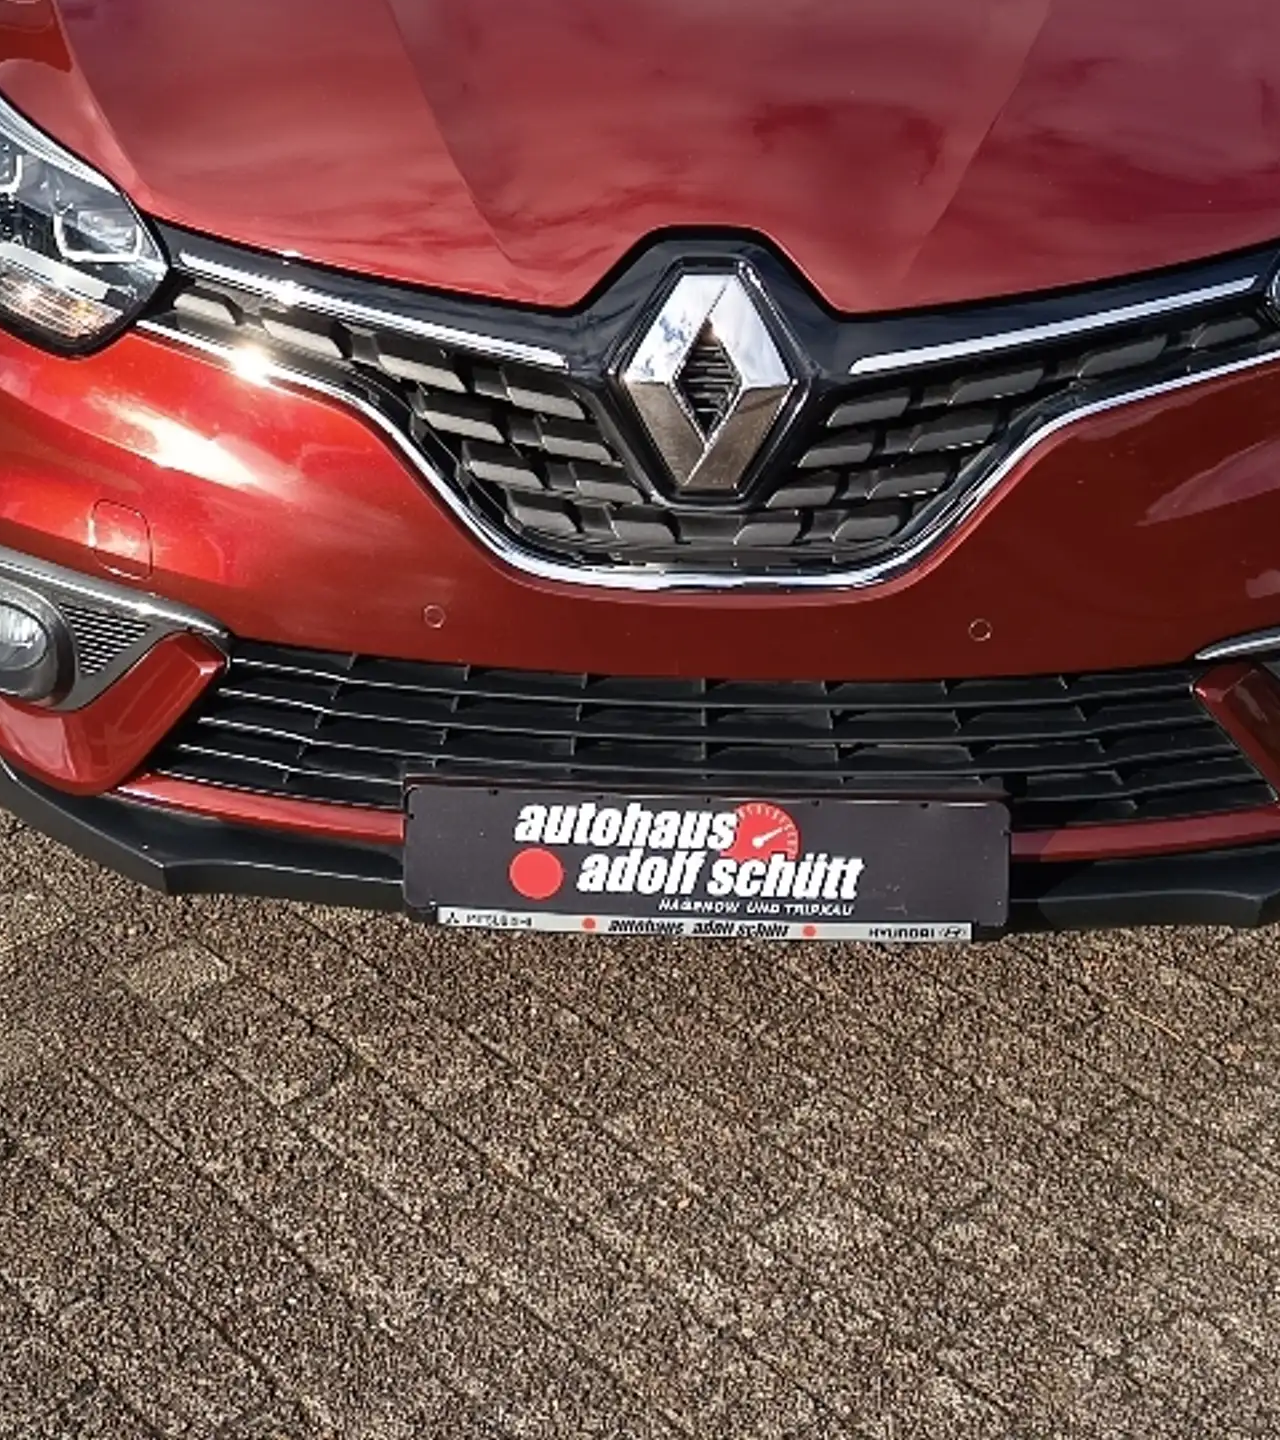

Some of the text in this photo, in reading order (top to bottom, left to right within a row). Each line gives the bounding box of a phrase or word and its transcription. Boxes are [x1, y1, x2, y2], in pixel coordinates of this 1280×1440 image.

[514, 802, 738, 850] autohaus
[576, 845, 865, 901] adolf schütt
[746, 901, 780, 915] UND
